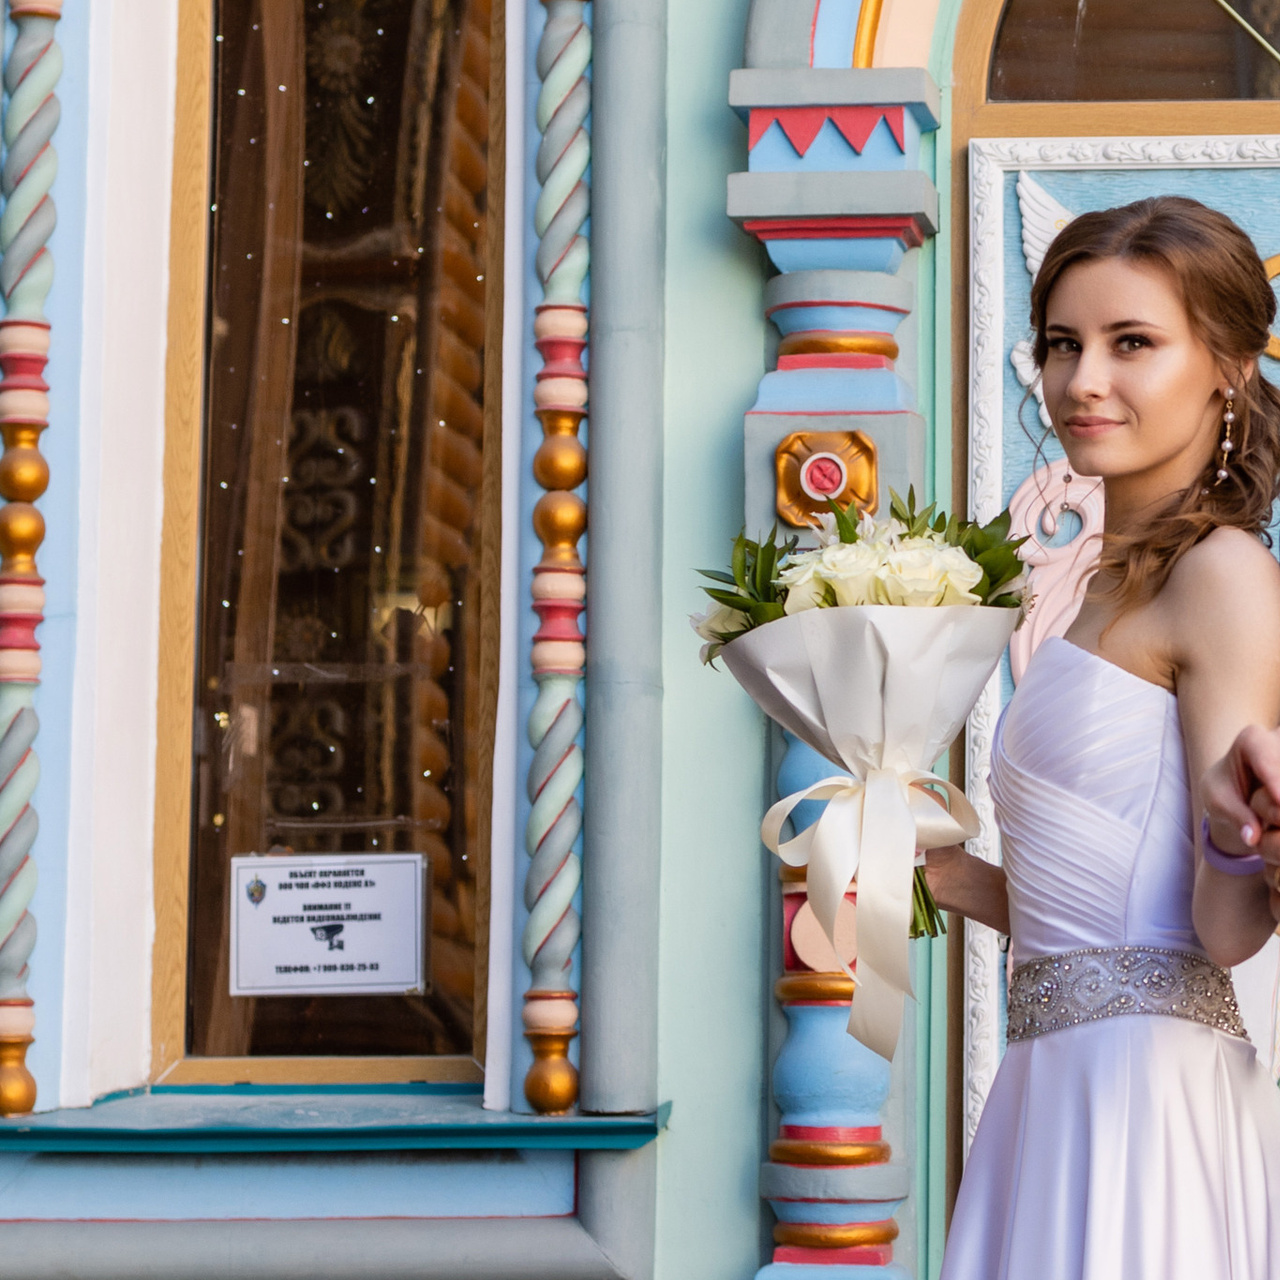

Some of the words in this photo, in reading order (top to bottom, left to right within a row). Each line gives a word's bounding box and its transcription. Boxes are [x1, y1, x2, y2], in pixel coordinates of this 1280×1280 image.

[303, 903, 342, 911] ВНИМАНИЕ
[272, 915, 304, 924] ВЕДЕТСЯ
[306, 913, 382, 923] ВИДЕОНАБЛЮДЕНИЕ
